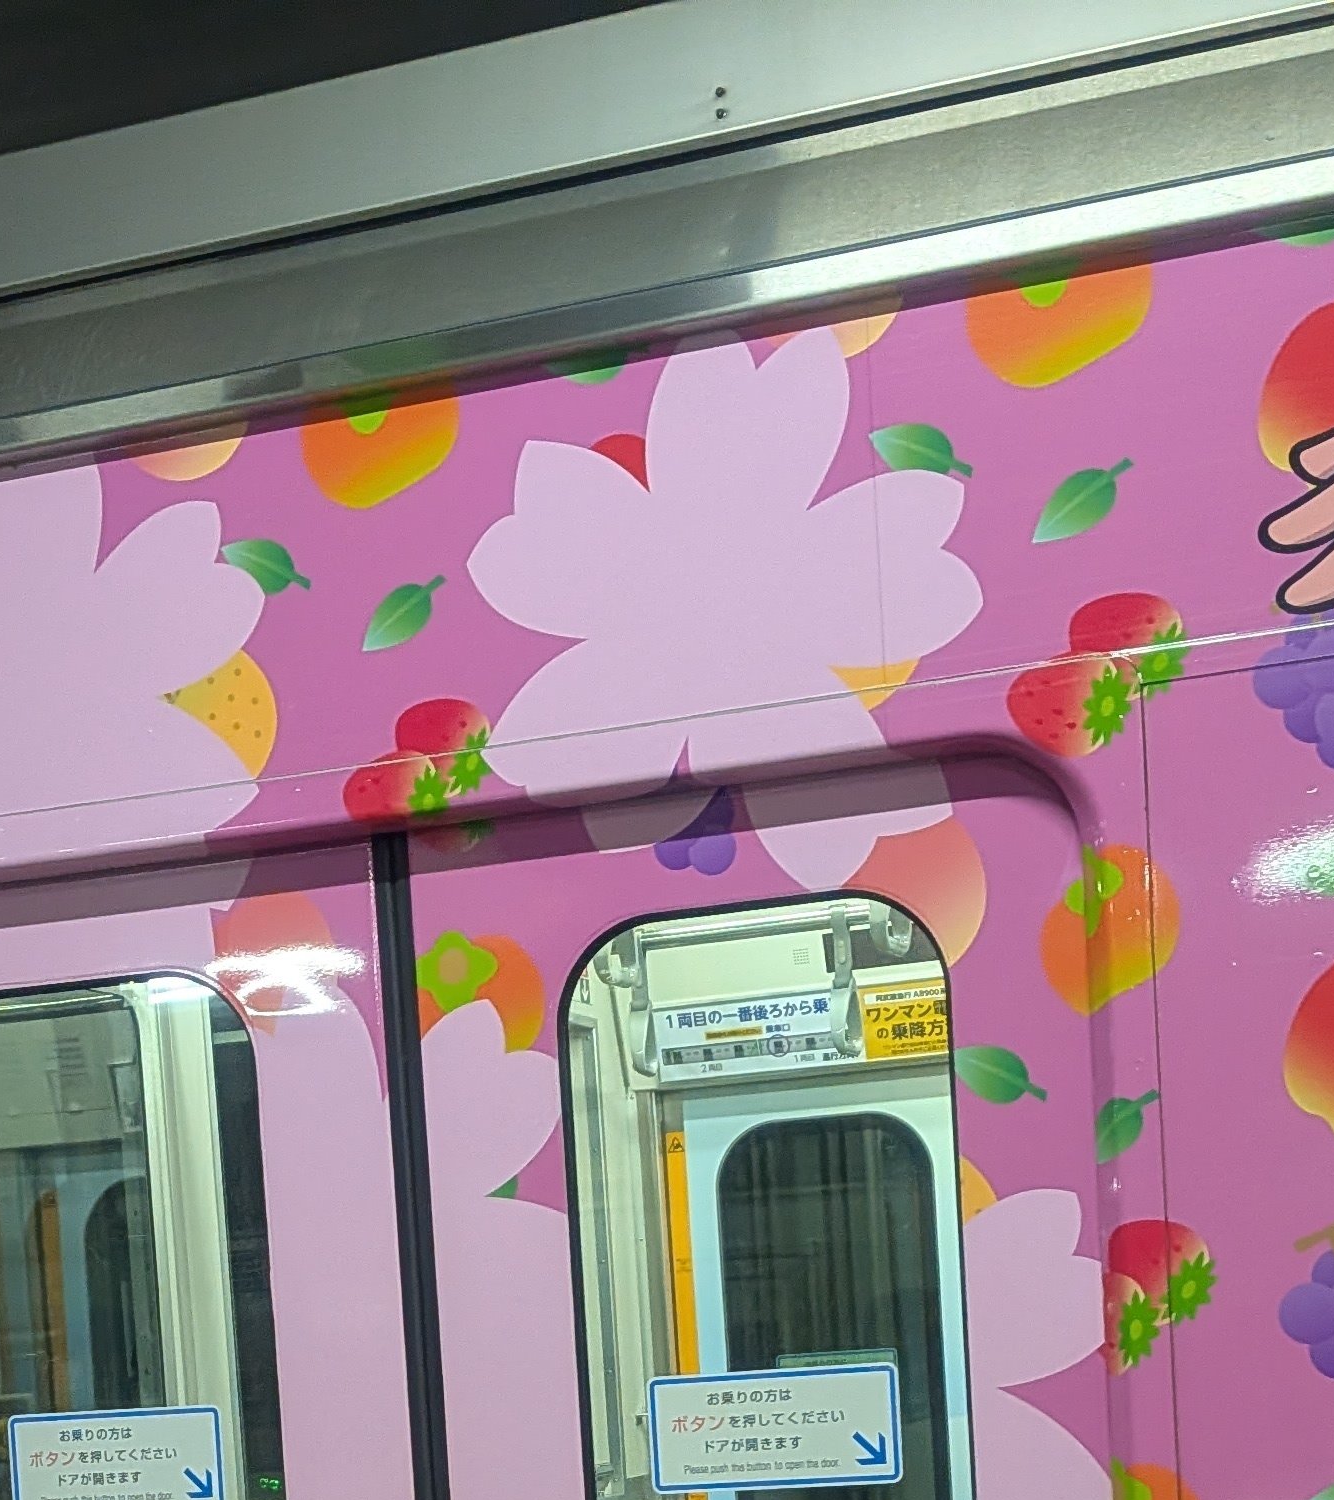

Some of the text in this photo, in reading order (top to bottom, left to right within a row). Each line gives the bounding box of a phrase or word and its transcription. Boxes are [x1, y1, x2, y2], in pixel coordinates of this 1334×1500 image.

[666, 998, 831, 1029] 1両目の一番後ろから乗
[876, 1019, 948, 1040] の乗降方
[706, 1388, 792, 1406] お乗りの方は
[671, 1409, 845, 1433] ボタンを押してください
[59, 1427, 132, 1442] お乗りの方は
[704, 1436, 802, 1453] ドアが開きます
[29, 1447, 178, 1467] ボタンを押してください
[774, 1460, 783, 1470] to
[57, 1471, 141, 1487] ドアが開きます
